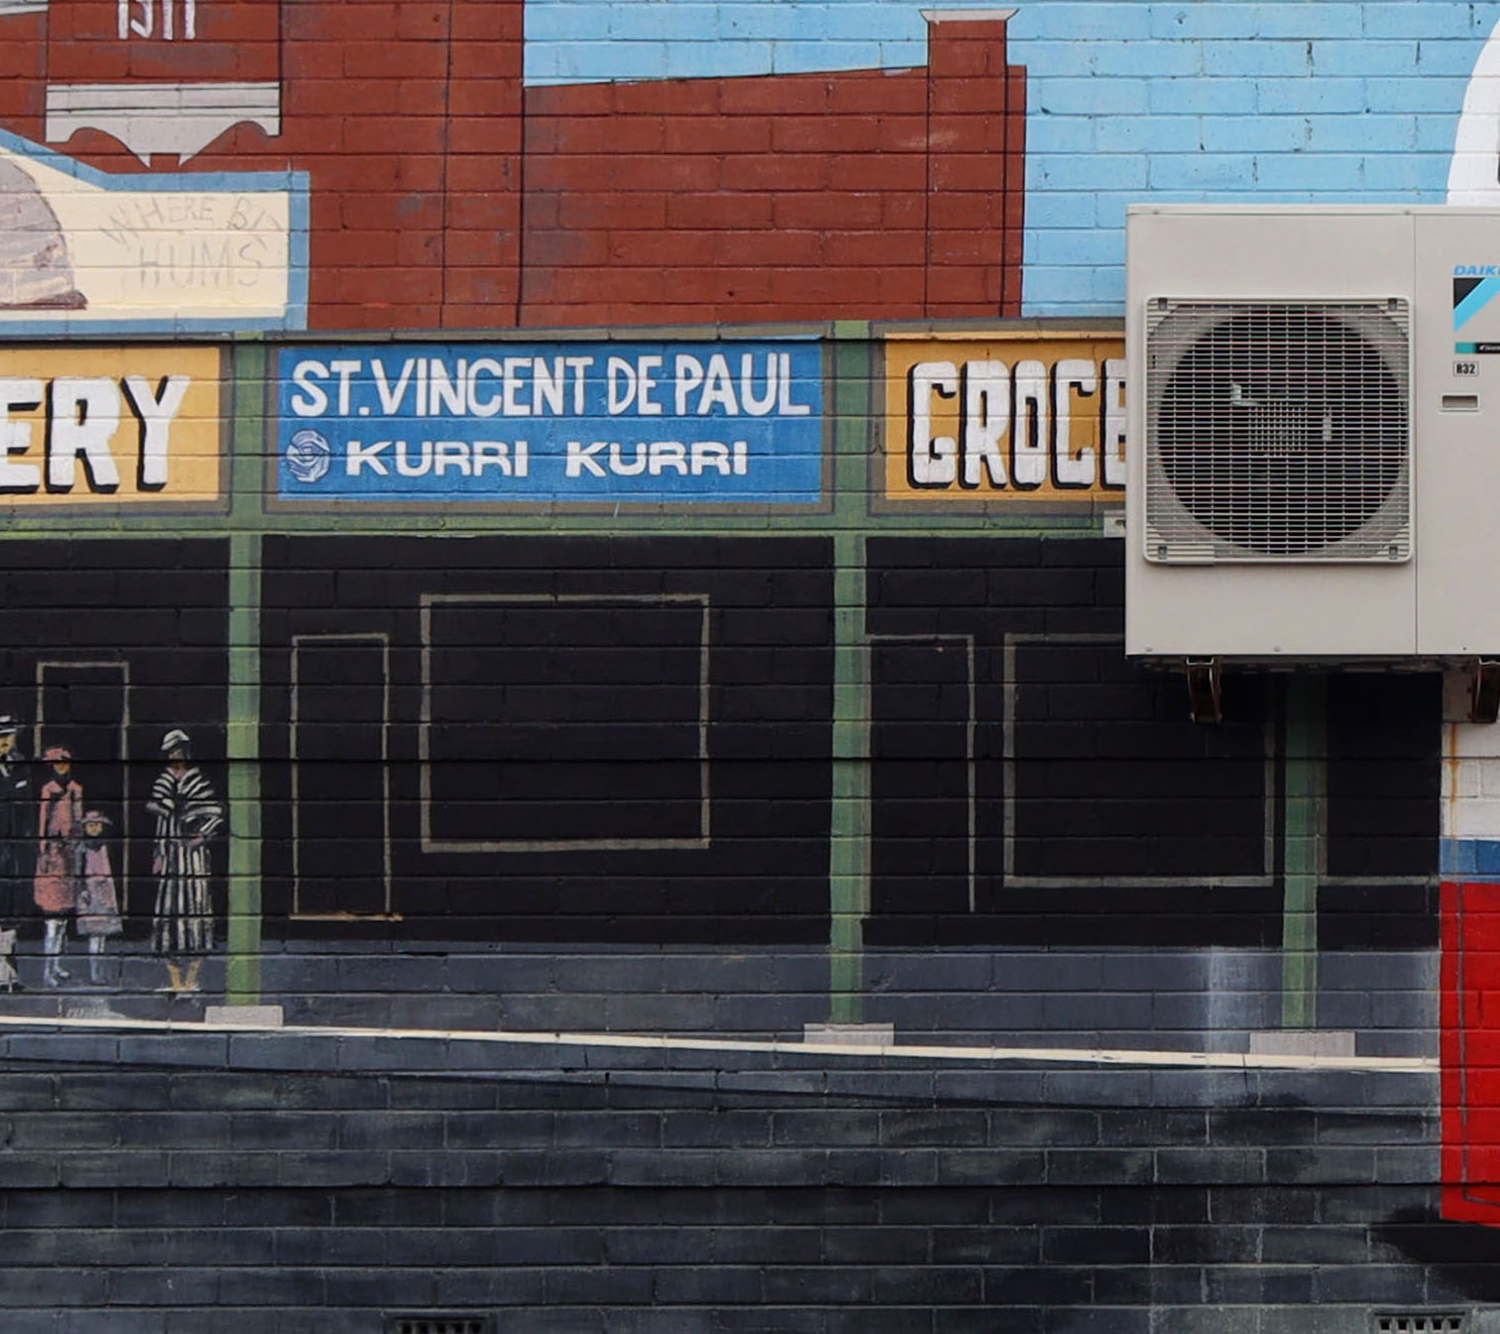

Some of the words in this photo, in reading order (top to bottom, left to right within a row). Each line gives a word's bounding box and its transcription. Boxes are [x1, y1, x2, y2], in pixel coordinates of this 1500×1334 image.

[100, 196, 217, 251] WHERE
[139, 238, 262, 290] HUMS
[606, 355, 663, 416] DE
[675, 353, 811, 417] PAUL
[345, 440, 529, 478] KURRI
[565, 440, 749, 478] KURRI
